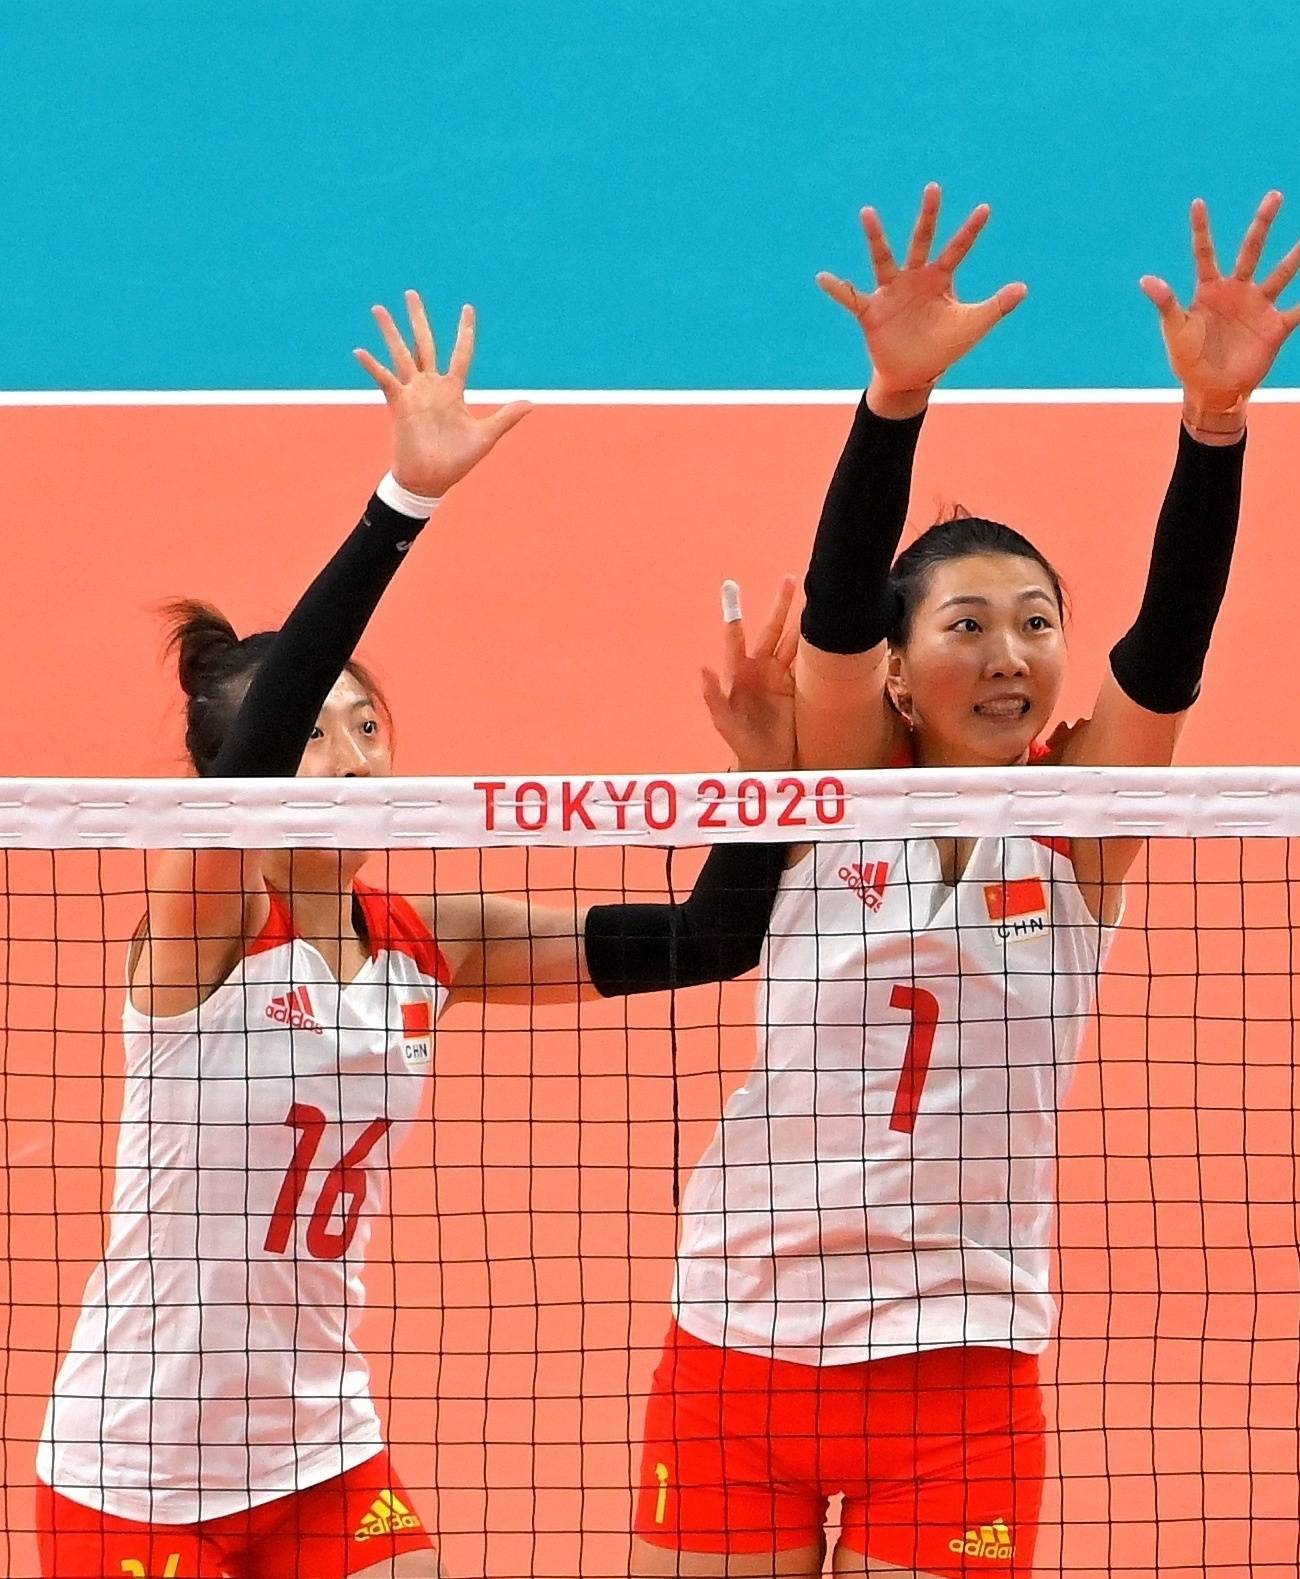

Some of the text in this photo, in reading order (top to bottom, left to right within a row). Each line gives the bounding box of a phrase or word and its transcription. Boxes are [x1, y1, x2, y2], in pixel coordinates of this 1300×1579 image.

[474, 776, 846, 832] TOKYO 2020
[997, 917, 1044, 939] CHN
[265, 1004, 324, 1036] adidas
[405, 1042, 428, 1060] CHN
[263, 1103, 394, 1260] 16
